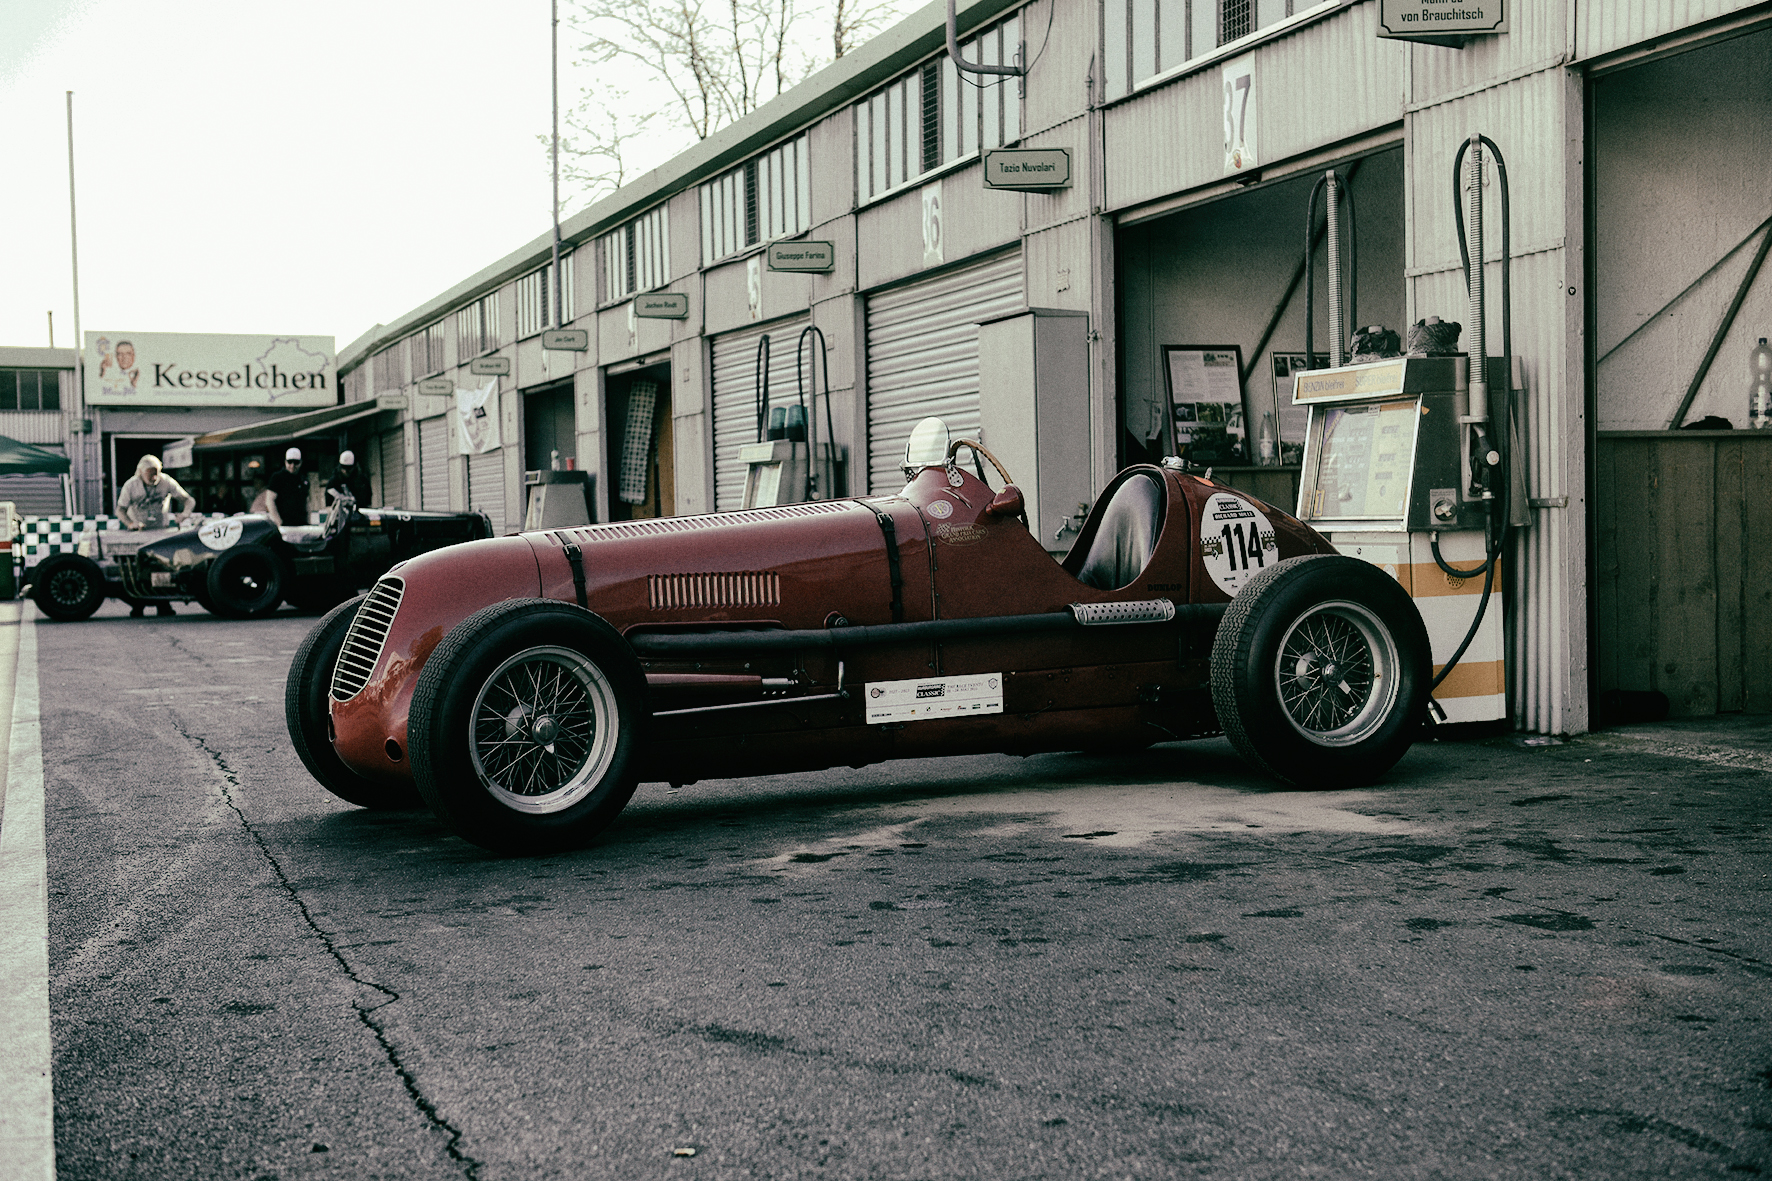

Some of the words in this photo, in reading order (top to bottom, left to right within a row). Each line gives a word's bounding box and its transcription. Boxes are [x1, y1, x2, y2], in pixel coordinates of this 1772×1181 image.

[1400, 12, 1419, 22] von
[1421, 7, 1484, 21] Brauchitsch
[999, 162, 1020, 173] Tazio
[1021, 161, 1056, 172] Nuvolari
[804, 250, 825, 259] Farina
[152, 363, 327, 389] Kesselchen
[1303, 381, 1324, 393] BENZIN
[1221, 522, 1264, 571] 114
[1147, 583, 1182, 591] DUNLOP
